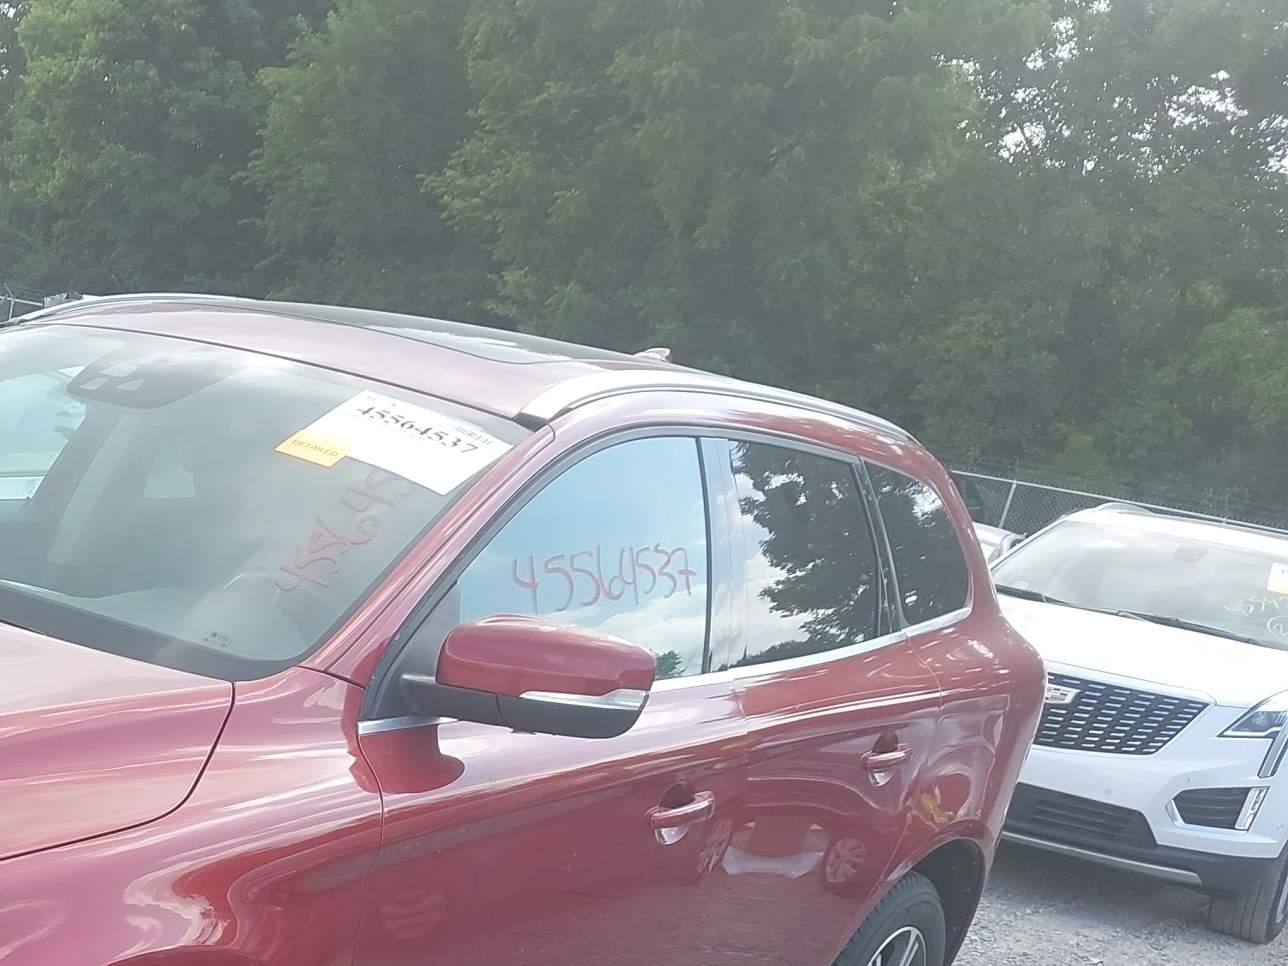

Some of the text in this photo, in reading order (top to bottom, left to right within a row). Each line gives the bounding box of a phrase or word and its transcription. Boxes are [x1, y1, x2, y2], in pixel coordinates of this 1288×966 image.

[291, 438, 340, 458] DETAILED
[357, 405, 480, 454] 45564537
[513, 542, 697, 615] 45564537
